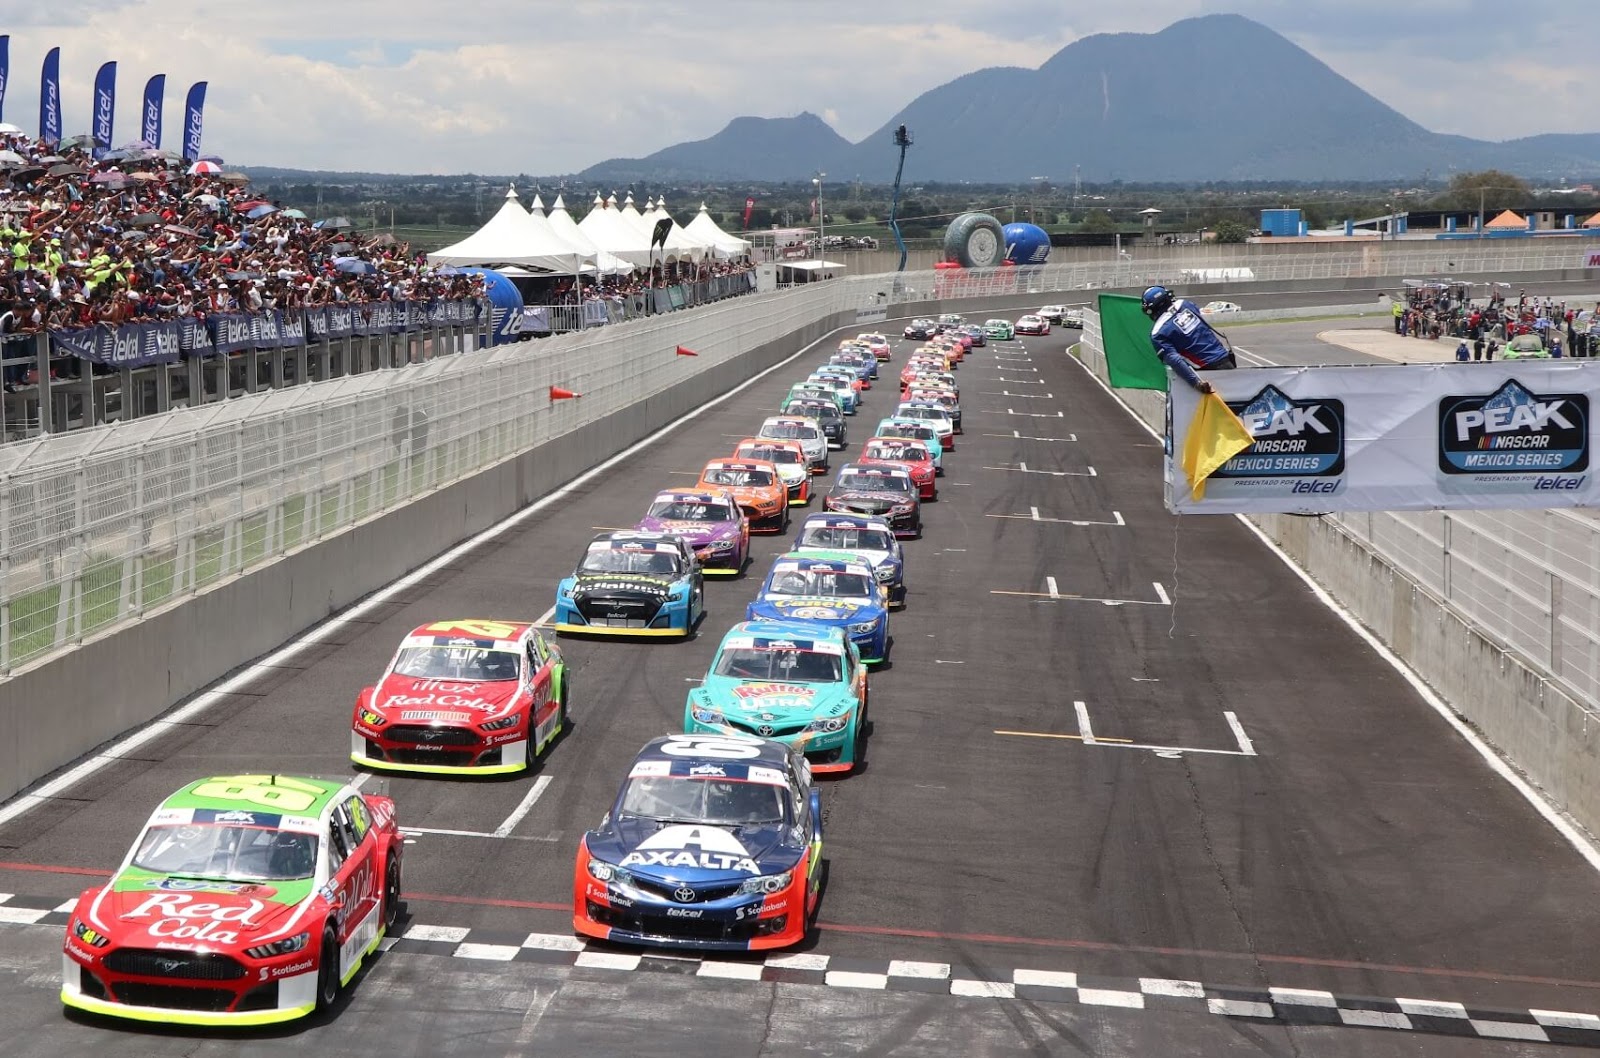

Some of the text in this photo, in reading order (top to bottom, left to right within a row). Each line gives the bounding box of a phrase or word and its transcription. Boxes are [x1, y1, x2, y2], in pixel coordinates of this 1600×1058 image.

[46, 79, 57, 132] telcel
[97, 89, 111, 144] telcel
[188, 107, 202, 152] telcel
[112, 332, 139, 362] telcel
[1242, 404, 1332, 437] EAK
[1455, 400, 1576, 442] PEAK
[1254, 439, 1307, 453] NASCAR
[1495, 435, 1550, 449] NASCAR
[1224, 457, 1320, 471] MEXICO SERIES
[1464, 453, 1563, 467] MEXICO SERIES
[1291, 479, 1342, 494] telcel
[1534, 475, 1587, 490] telcel
[381, 694, 498, 715] Red Cola
[738, 698, 812, 711] ULTRA
[618, 851, 762, 875] AXALTA
[593, 888, 634, 907] Scotiabank
[747, 899, 787, 915] Scotiabank
[120, 893, 264, 926] Red
[666, 907, 703, 918] telcel
[148, 917, 239, 944] Cola
[272, 959, 314, 976] Scotiabank
